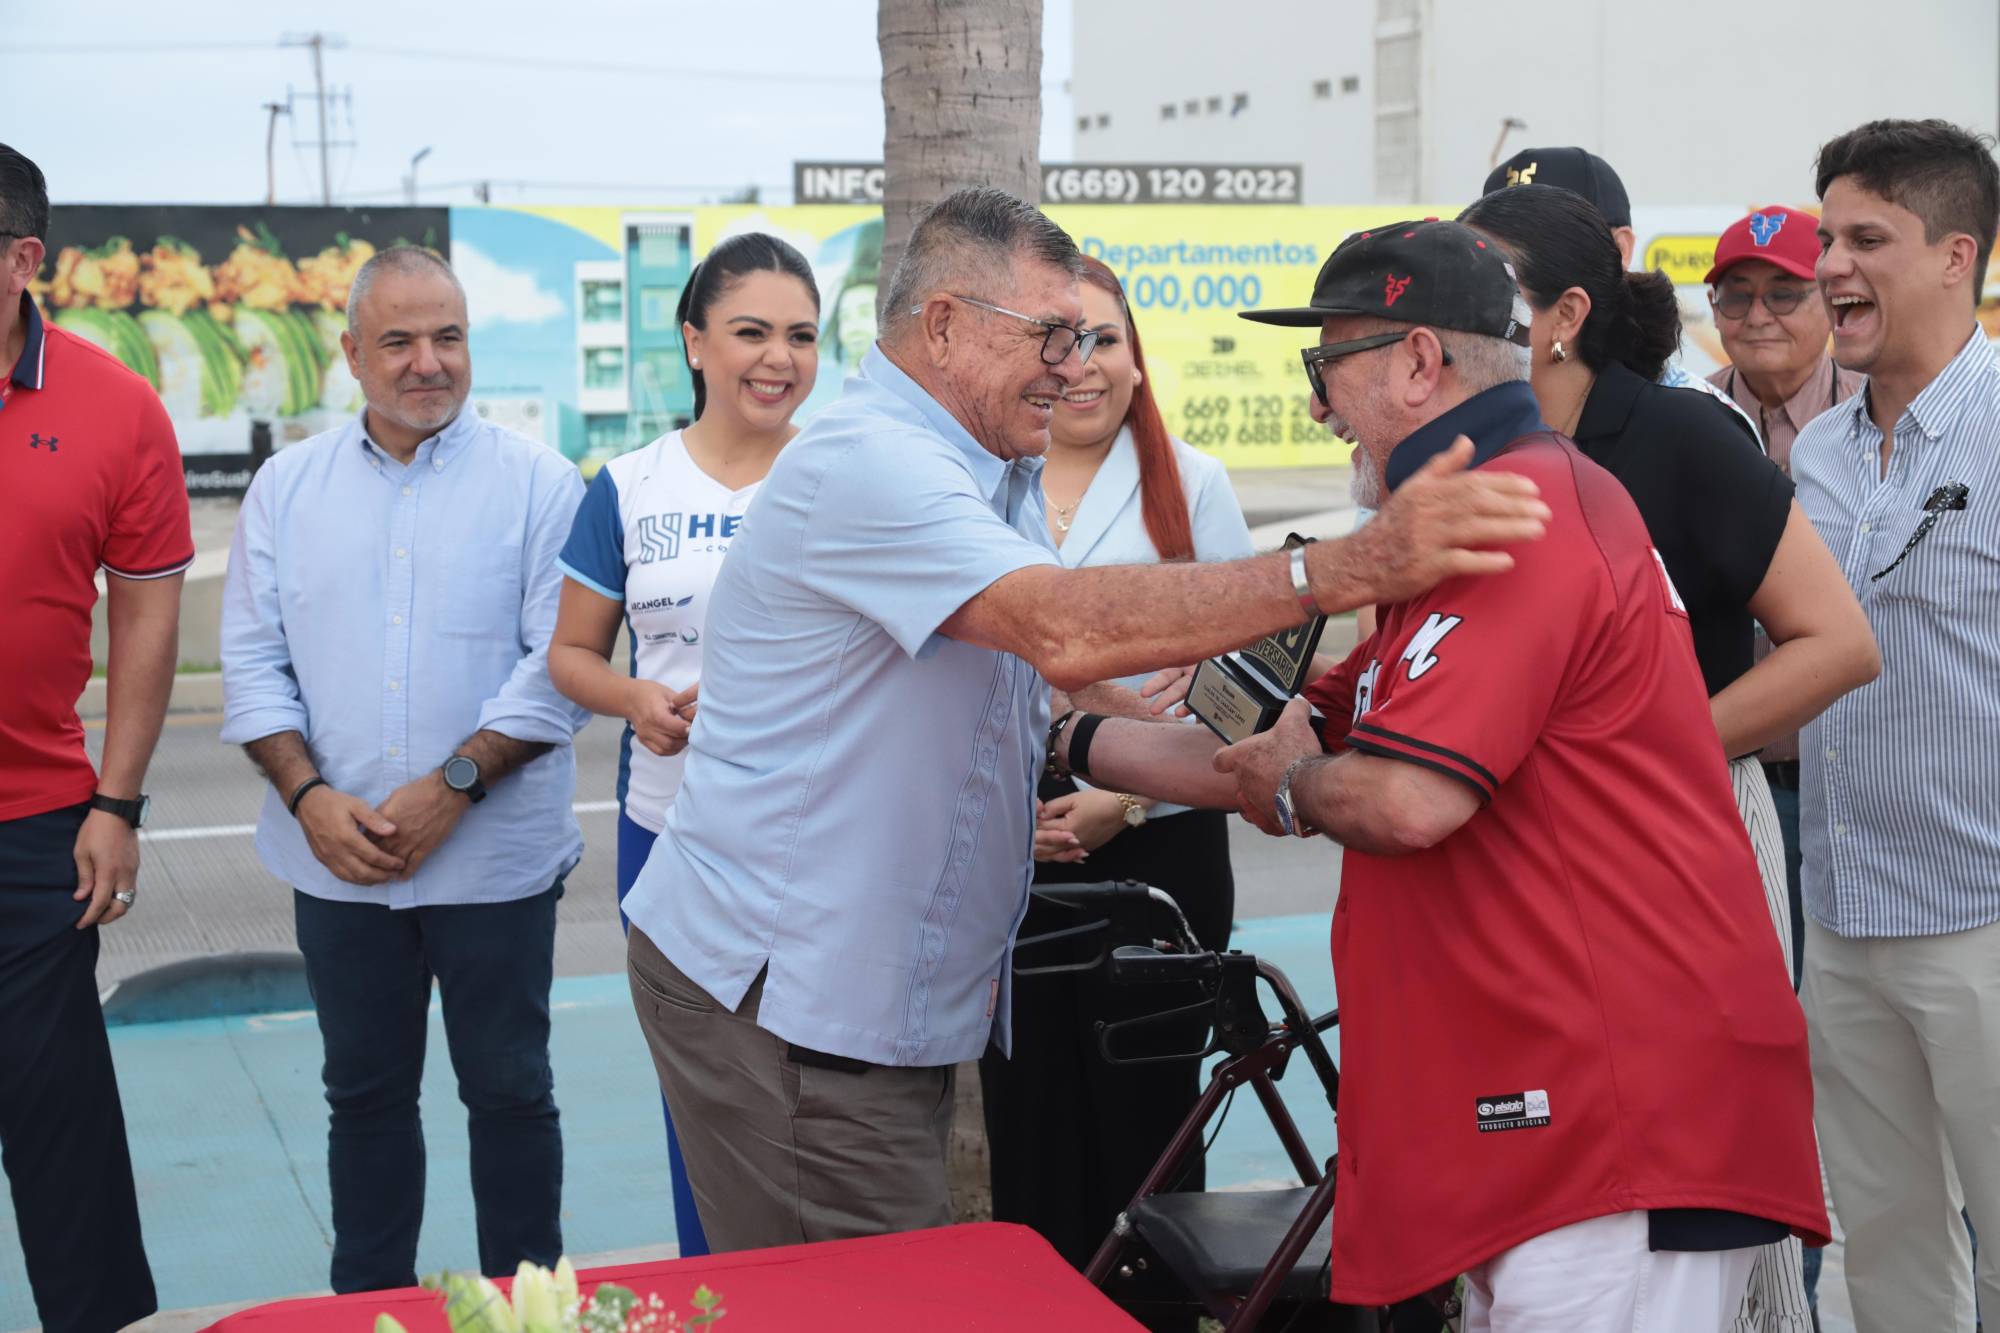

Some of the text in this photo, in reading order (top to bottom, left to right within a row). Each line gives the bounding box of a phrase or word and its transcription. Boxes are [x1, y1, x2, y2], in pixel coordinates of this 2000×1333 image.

[1045, 168, 1140, 201] (669)
[1147, 168, 1206, 198] 120
[1213, 168, 1296, 198] 2022
[1083, 237, 1317, 271] Departamentos
[1183, 396, 1230, 419] 669
[1239, 396, 1283, 418] 120
[1184, 422, 1230, 445] 669
[1237, 422, 1282, 444] 688
[1480, 1118, 1548, 1131] PRODUCTO OFICIAL
